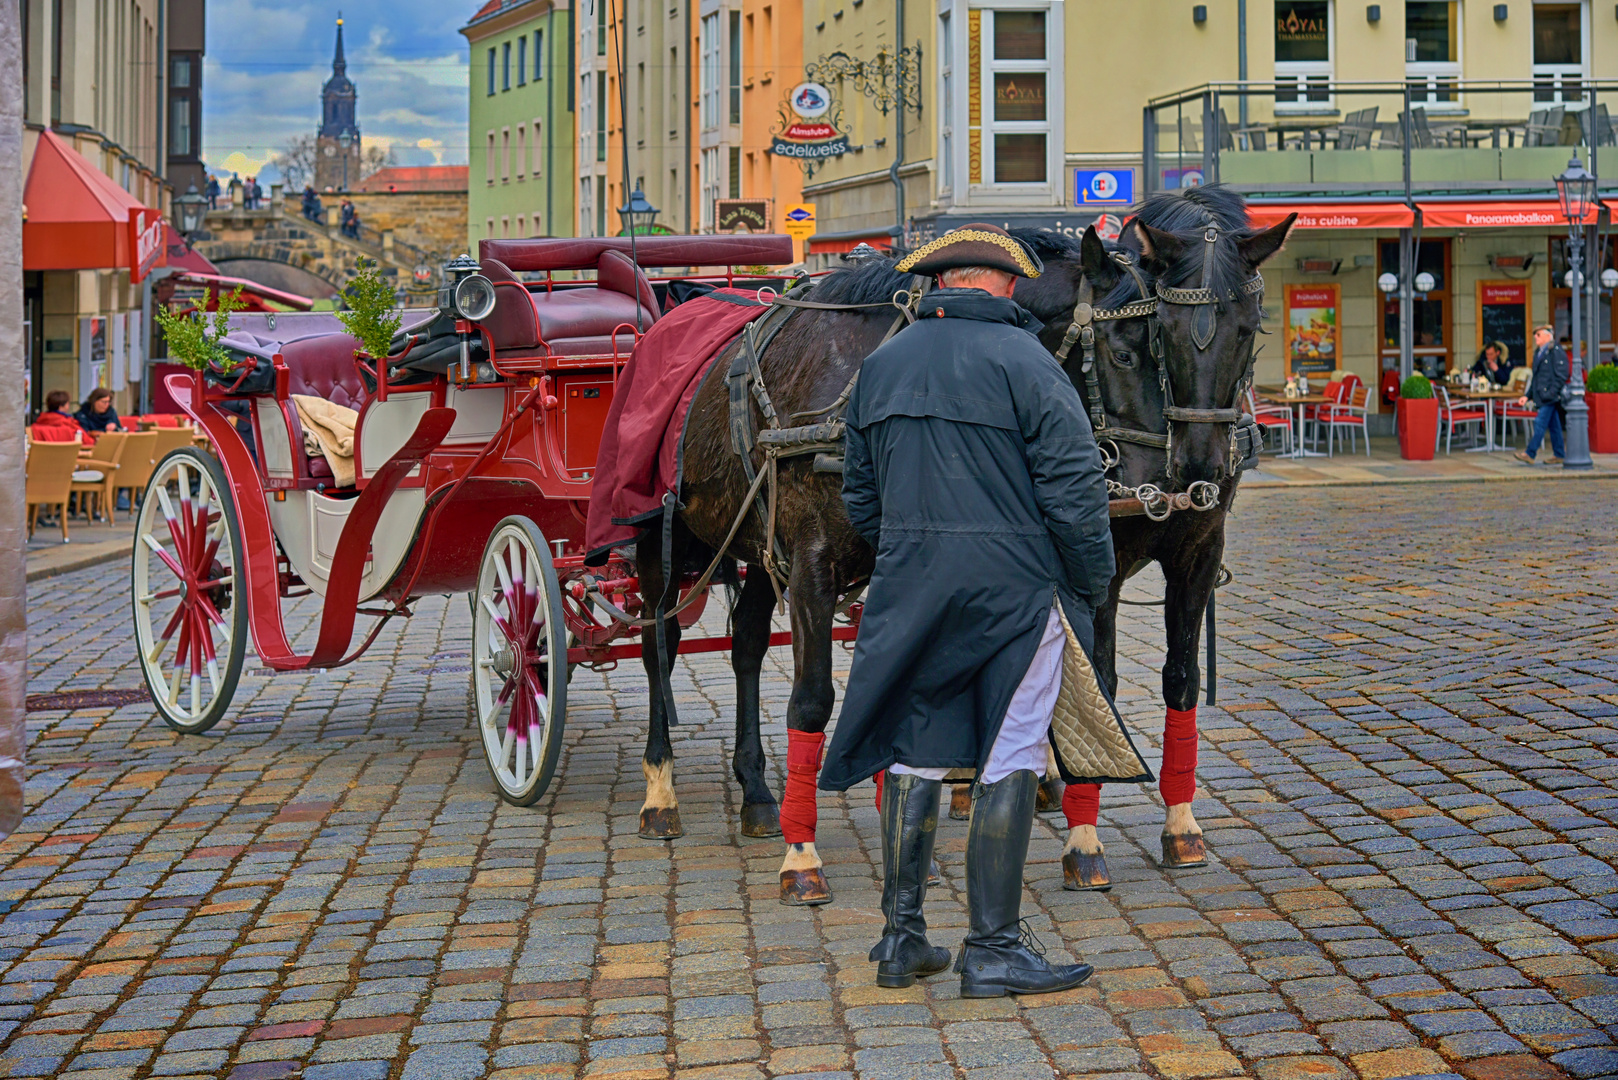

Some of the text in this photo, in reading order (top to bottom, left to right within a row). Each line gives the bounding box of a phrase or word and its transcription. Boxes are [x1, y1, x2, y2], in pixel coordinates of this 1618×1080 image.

[1277, 12, 1326, 32] ROYAL
[969, 14, 980, 179] ROYAL THAIMASSAGE
[997, 84, 1043, 99] ROYAL
[790, 127, 830, 136] Almstube
[775, 141, 846, 157] edelweiss
[720, 206, 765, 226] Las Tapas
[1319, 215, 1358, 226] cuisine
[1465, 212, 1555, 225] Panoramabalkon
[1296, 292, 1329, 300] Frühstück
